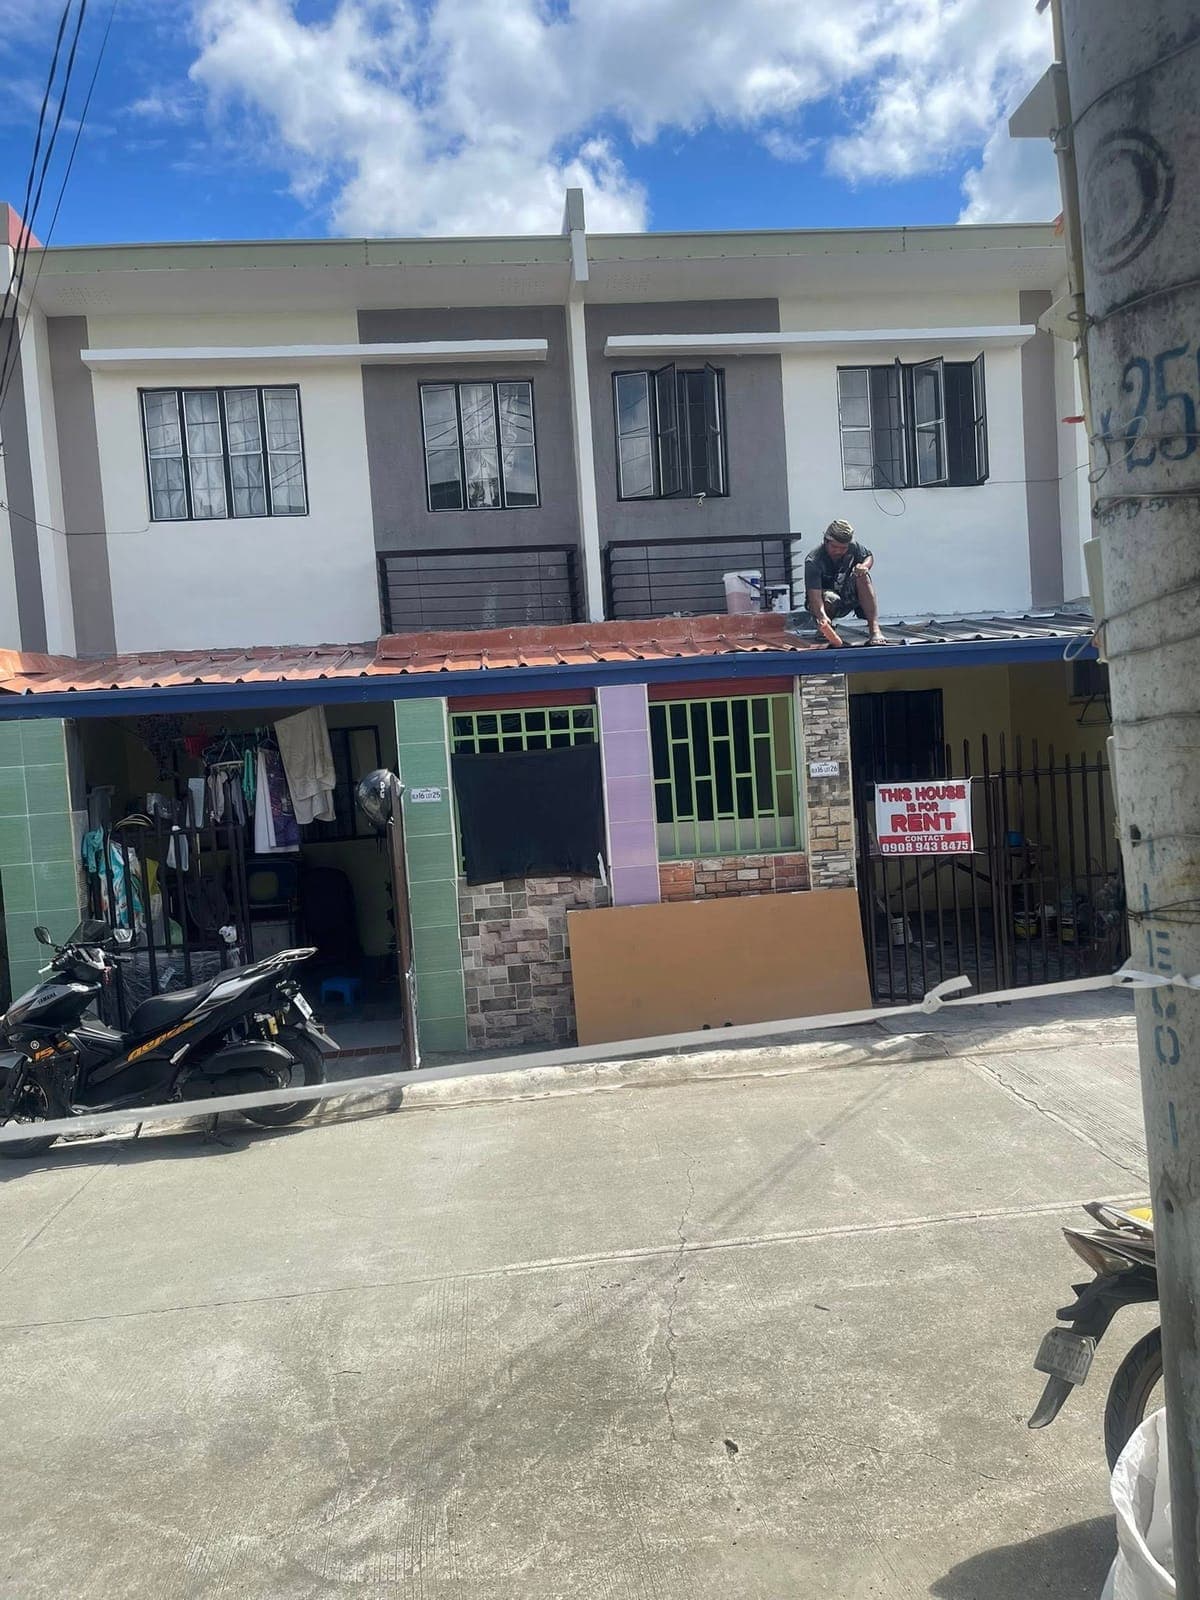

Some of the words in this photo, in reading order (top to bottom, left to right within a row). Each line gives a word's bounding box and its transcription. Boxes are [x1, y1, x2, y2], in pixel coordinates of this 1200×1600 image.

[1122, 341, 1200, 474] 25
[879, 787, 912, 802] THIS
[915, 785, 966, 801] HOUSE
[906, 803, 915, 813] IS
[918, 802, 939, 812] FOR
[890, 812, 956, 833] RENT
[905, 834, 944, 842] CONTACT
[882, 842, 913, 853] 0908
[915, 841, 938, 852] 943
